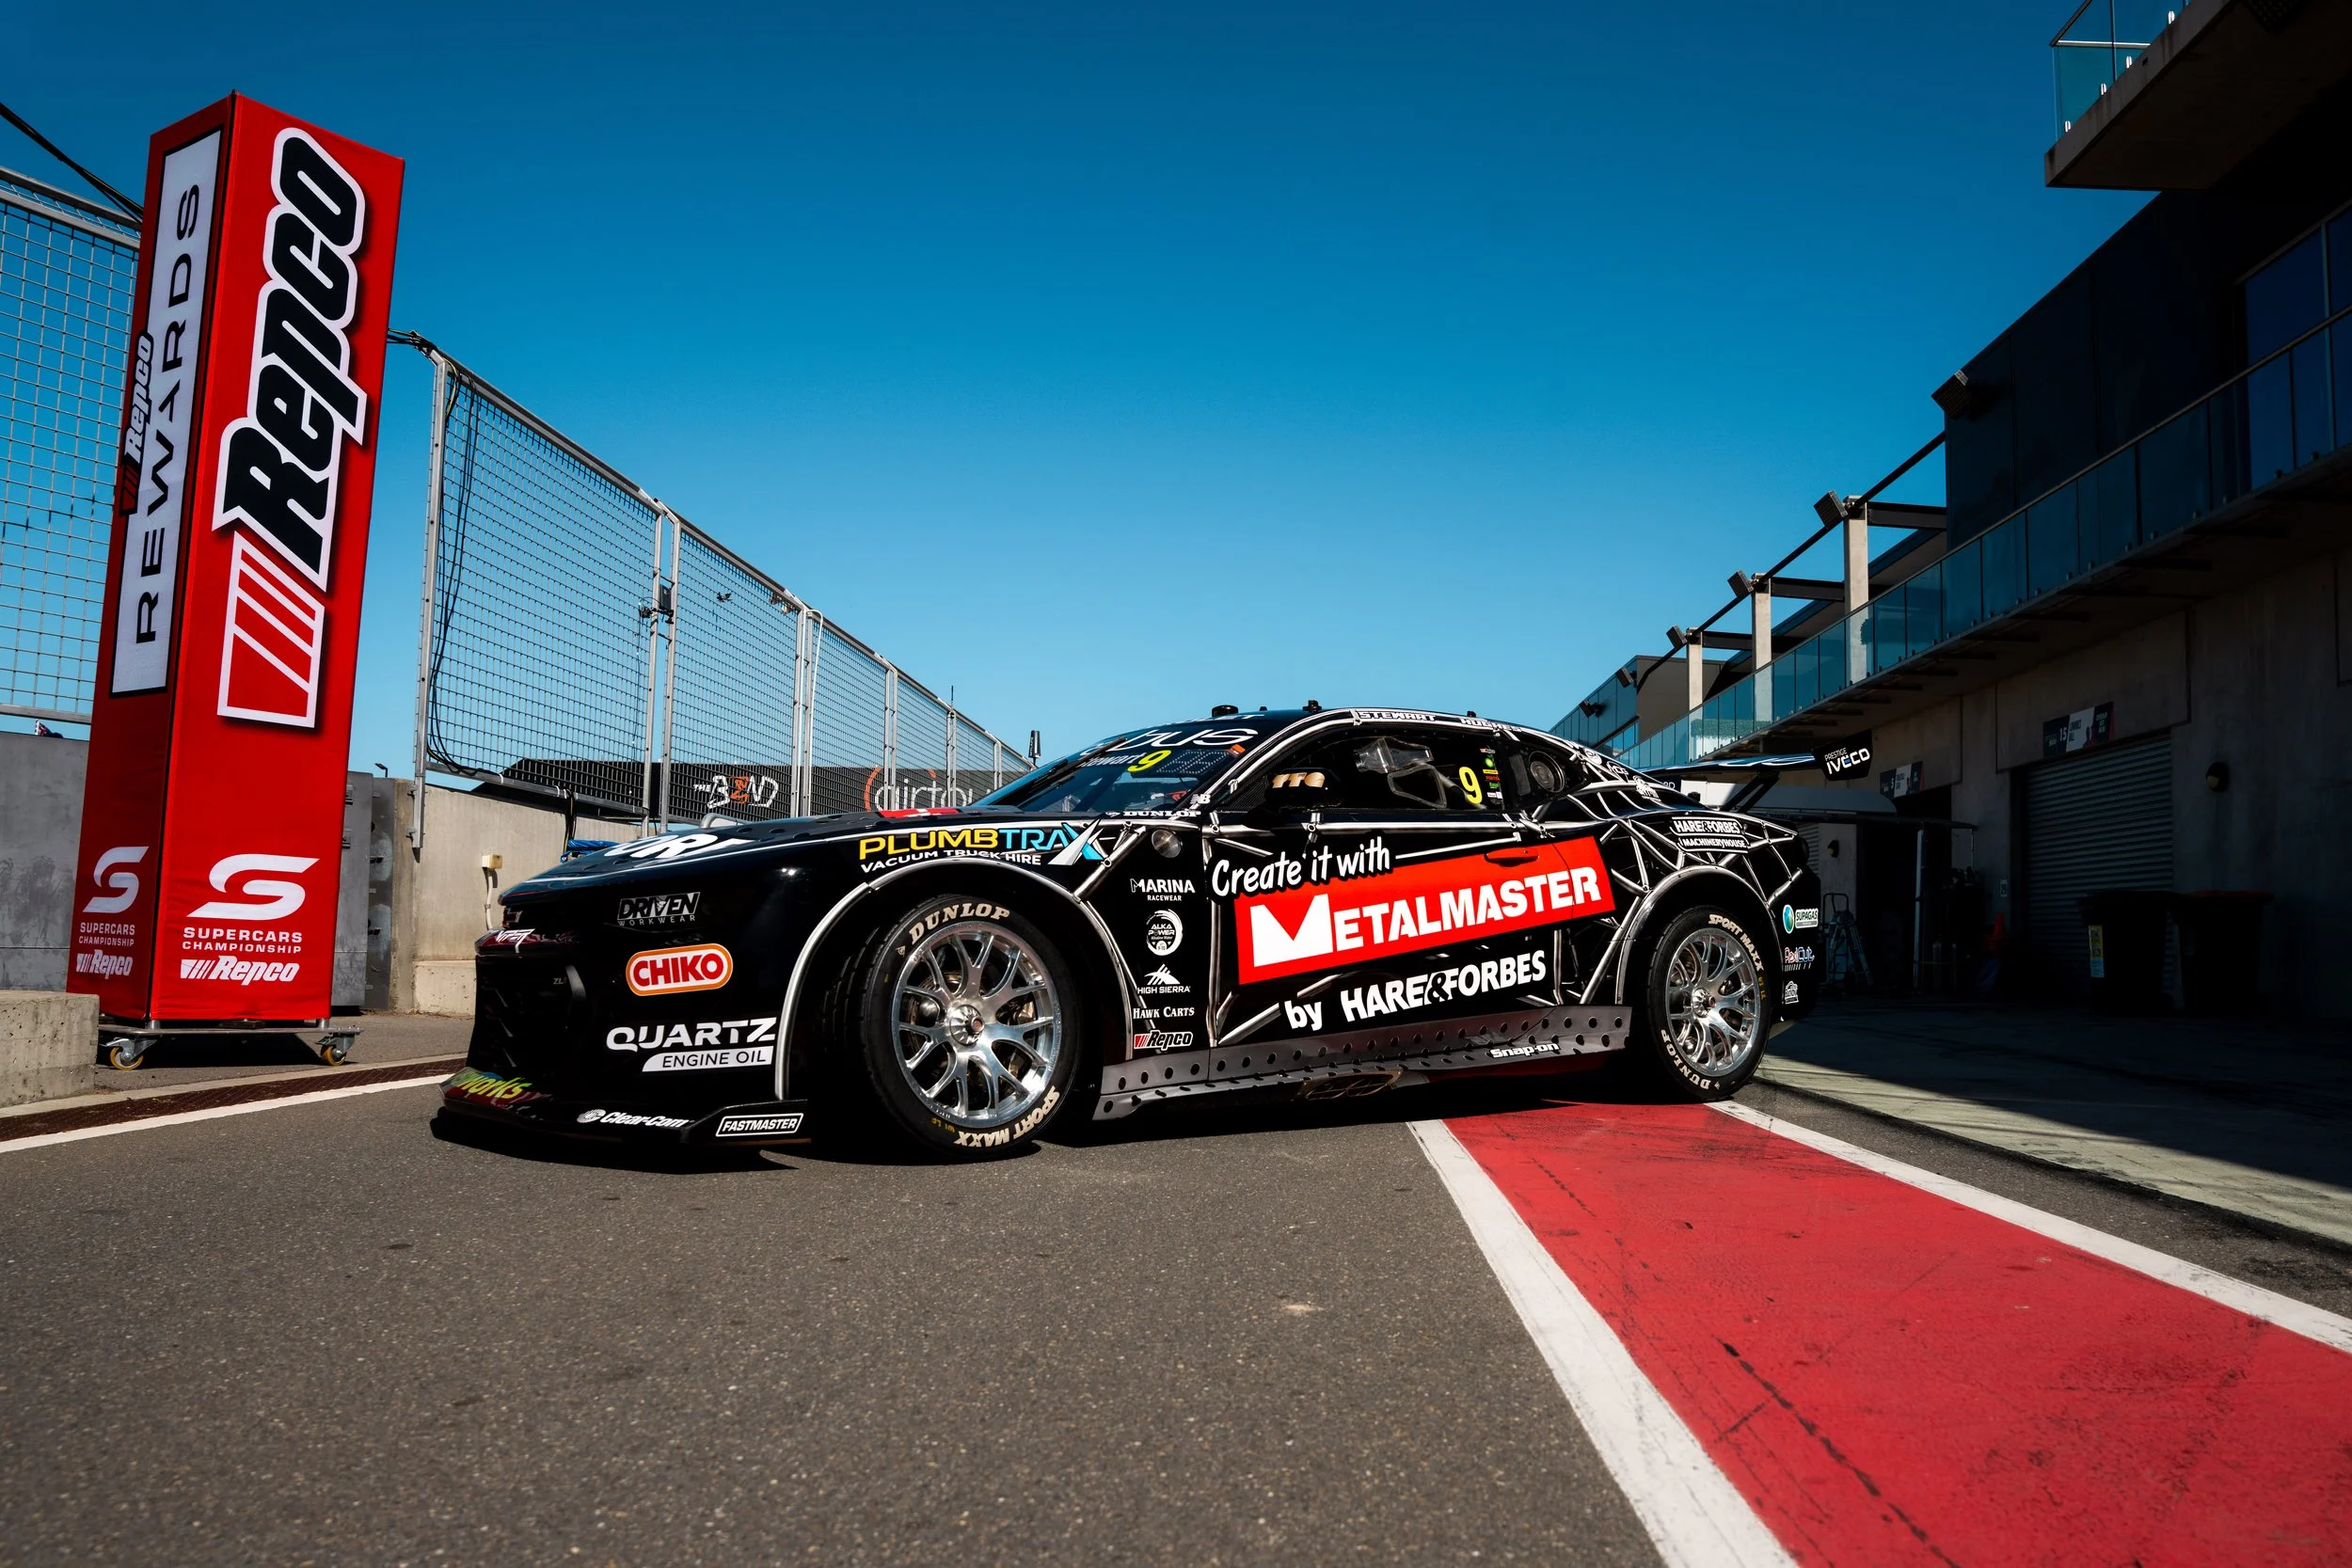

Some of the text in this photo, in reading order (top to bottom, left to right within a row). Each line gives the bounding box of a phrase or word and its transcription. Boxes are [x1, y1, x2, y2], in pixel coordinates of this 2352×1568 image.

[213, 127, 367, 594] Repco
[123, 329, 154, 469] Repco
[135, 182, 200, 644] REWARDS
[1127, 750, 1171, 772] 9
[1824, 747, 1848, 762] PRESTIGE
[1826, 748, 1870, 775] IVECO
[693, 783, 710, 792] THE
[1459, 767, 1483, 804] 9
[859, 818, 1105, 866] PLUMBTRAX
[861, 848, 1041, 874] VACUUM TRUCK HIRE
[1212, 835, 1391, 897] Create it with
[1130, 878, 1196, 894] MARINA
[617, 892, 700, 921] DRIVEN
[1249, 865, 1601, 967] METALMASTER
[80, 922, 135, 936] SUPERCARS
[617, 914, 696, 927] WORKWEAR
[909, 902, 1011, 945] DUNLOP
[78, 935, 135, 947] CHAMPIONSHIP
[182, 941, 302, 954] CHAMPIONSHIP
[183, 927, 303, 943] SUPERCARS
[1708, 913, 1765, 972] SPORT MAXX
[91, 949, 134, 979] Repco
[208, 955, 300, 986] Repco
[631, 953, 724, 987] CHIKO
[1159, 986, 1191, 994] SIERRA
[1133, 1006, 1195, 1019] HAWK CARTS
[1285, 1000, 1323, 1032] by
[606, 1017, 777, 1053] QUARTZ
[1147, 1030, 1194, 1051] Repco
[661, 1049, 767, 1069] ENGINE OIL
[1490, 1042, 1561, 1058] Snap-on
[1661, 1029, 1711, 1090] DUNLOP
[601, 1111, 690, 1129] Clear-Com
[722, 1117, 798, 1132] FASTMASTER
[954, 1085, 1060, 1148] SPORT MAXX
